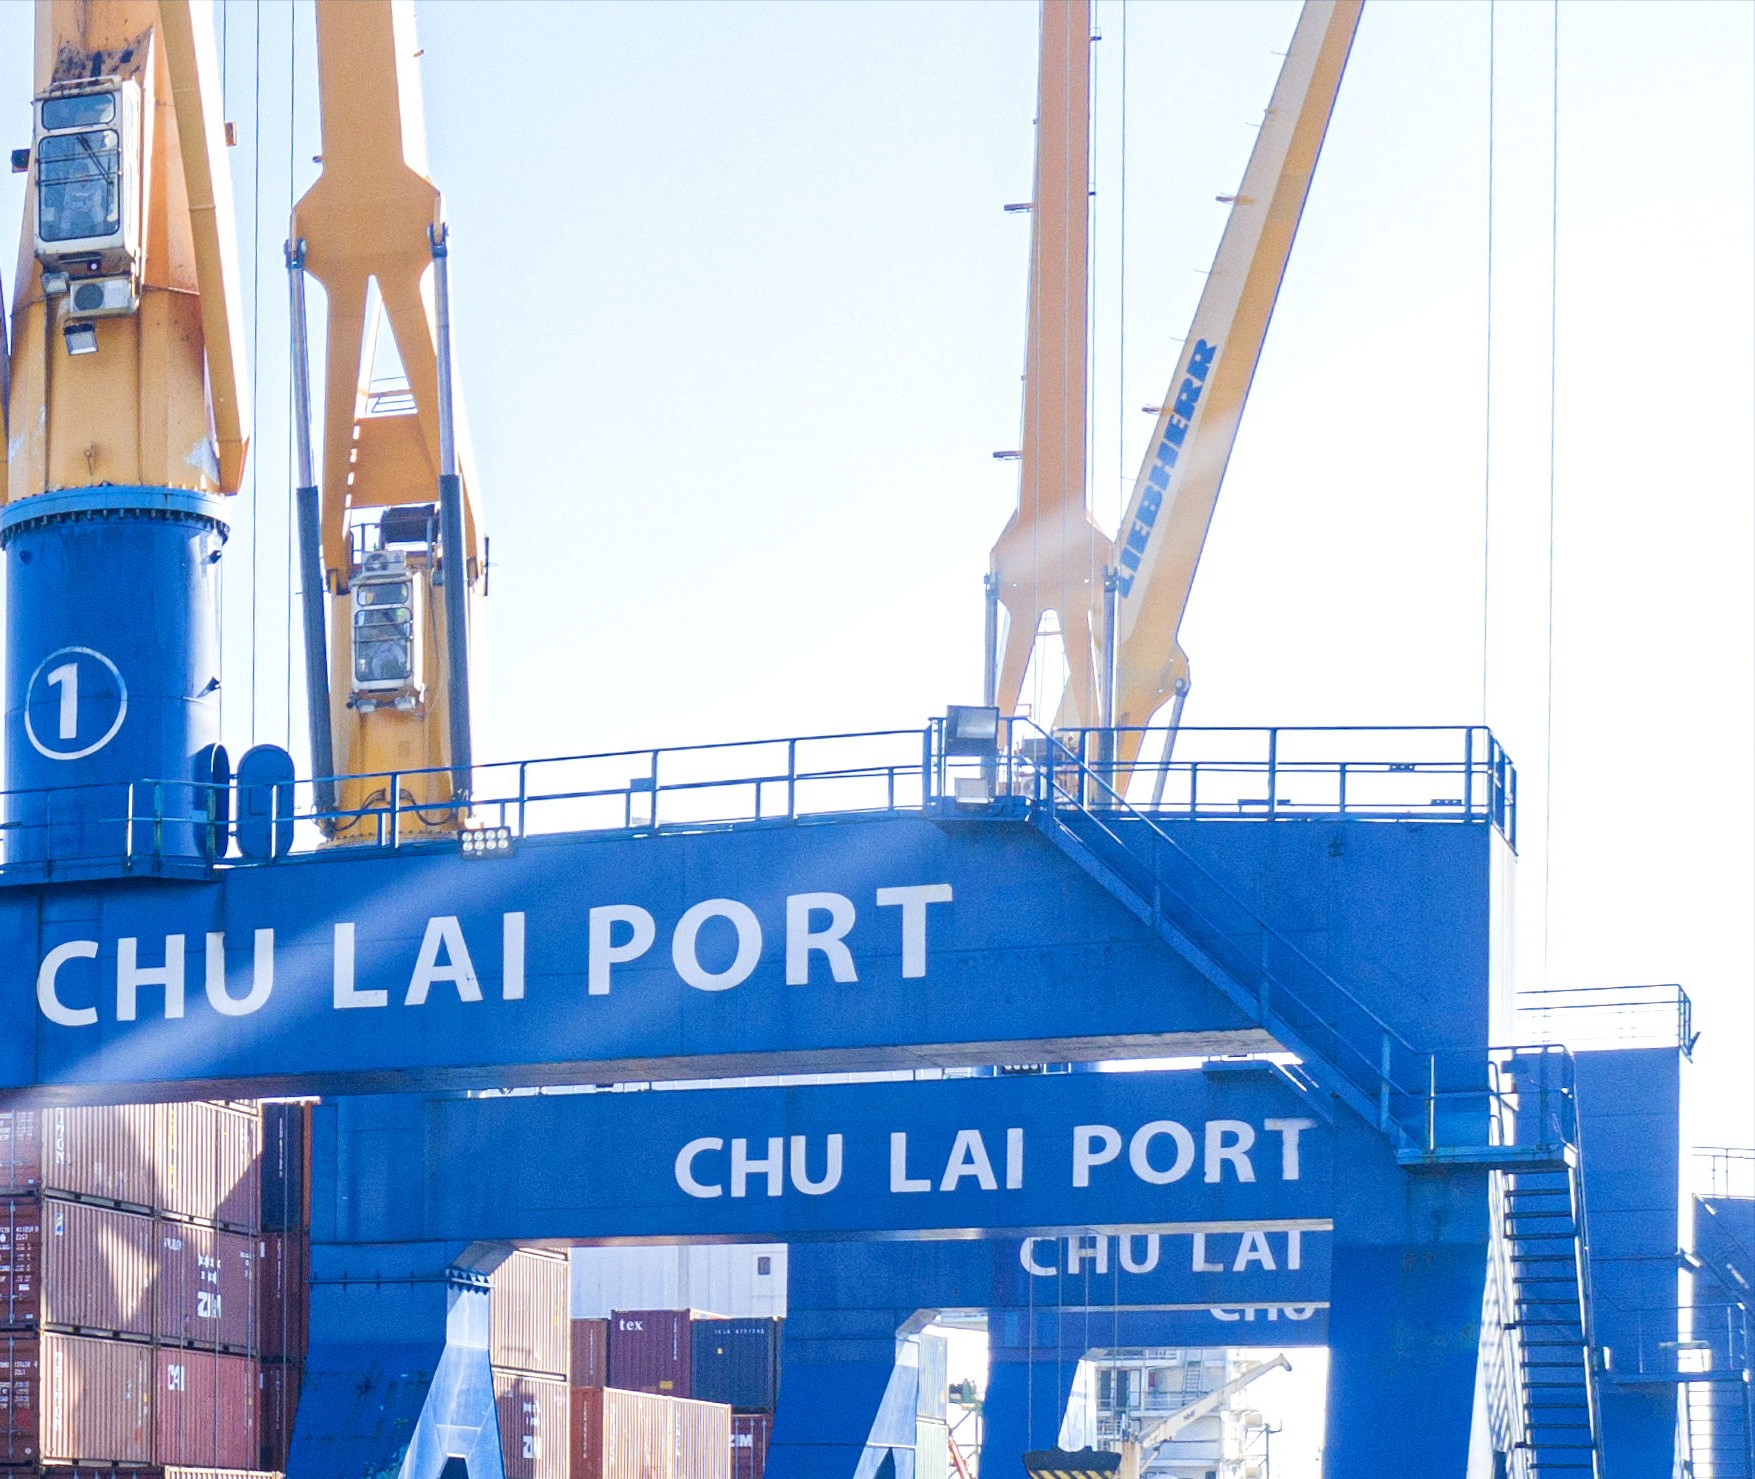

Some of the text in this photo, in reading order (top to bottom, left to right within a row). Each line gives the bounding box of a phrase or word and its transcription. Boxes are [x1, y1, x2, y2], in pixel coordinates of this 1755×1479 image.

[1117, 337, 1218, 600] LIEBHERR
[47, 662, 78, 740] 1
[36, 884, 953, 1028] CHU LAI PORT
[674, 1118, 1314, 1199] CHU LAI PORT
[1019, 1229, 1302, 1277] CHU LAI
[619, 1318, 644, 1332] tex
[730, 1434, 754, 1448] ZIM
